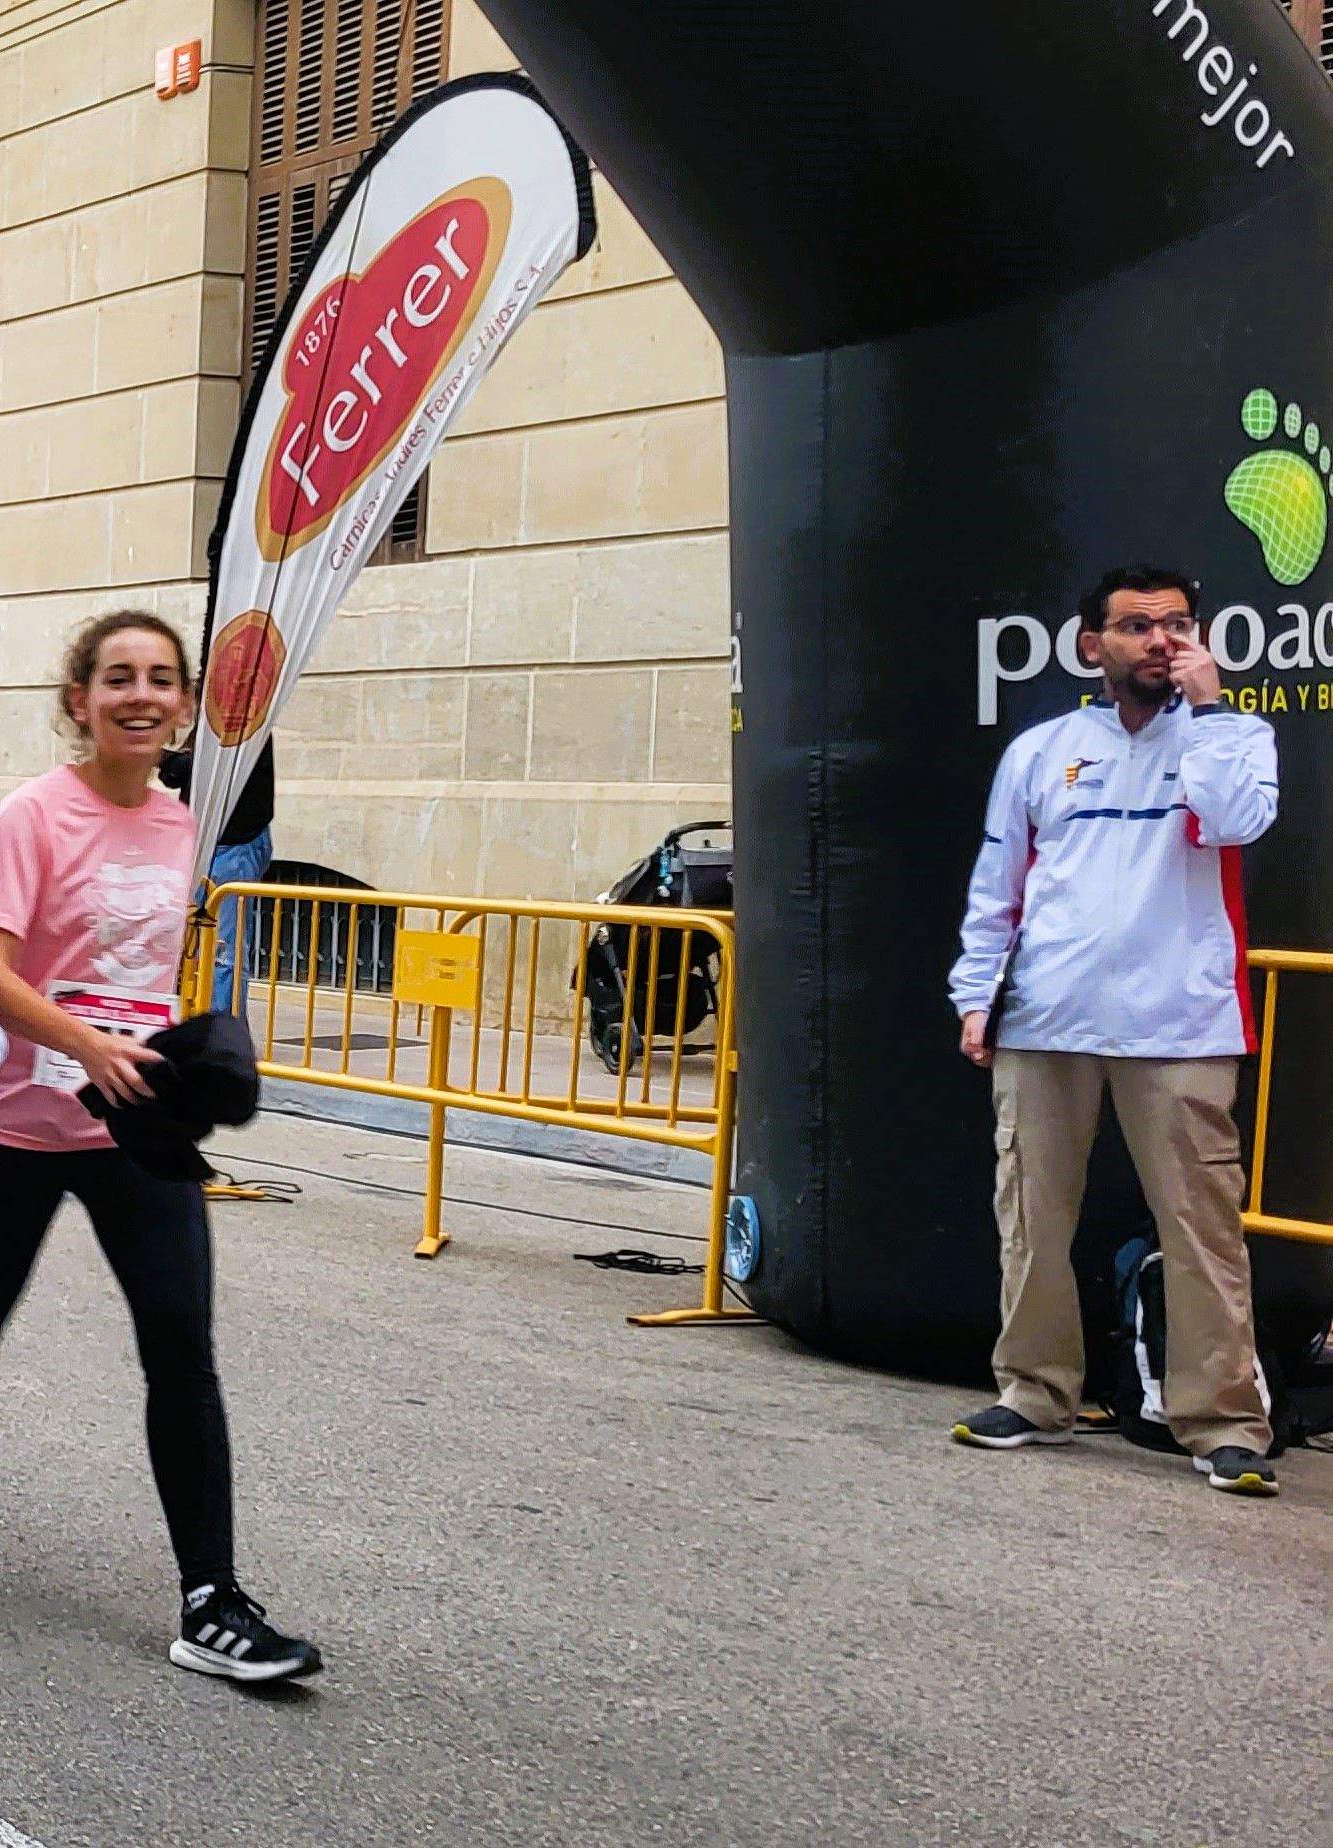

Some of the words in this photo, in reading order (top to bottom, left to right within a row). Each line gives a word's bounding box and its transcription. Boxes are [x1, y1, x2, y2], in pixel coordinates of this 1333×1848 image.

[1151, 0, 1295, 168] mejor
[280, 217, 470, 507] Ferrer
[295, 296, 341, 366] 1876
